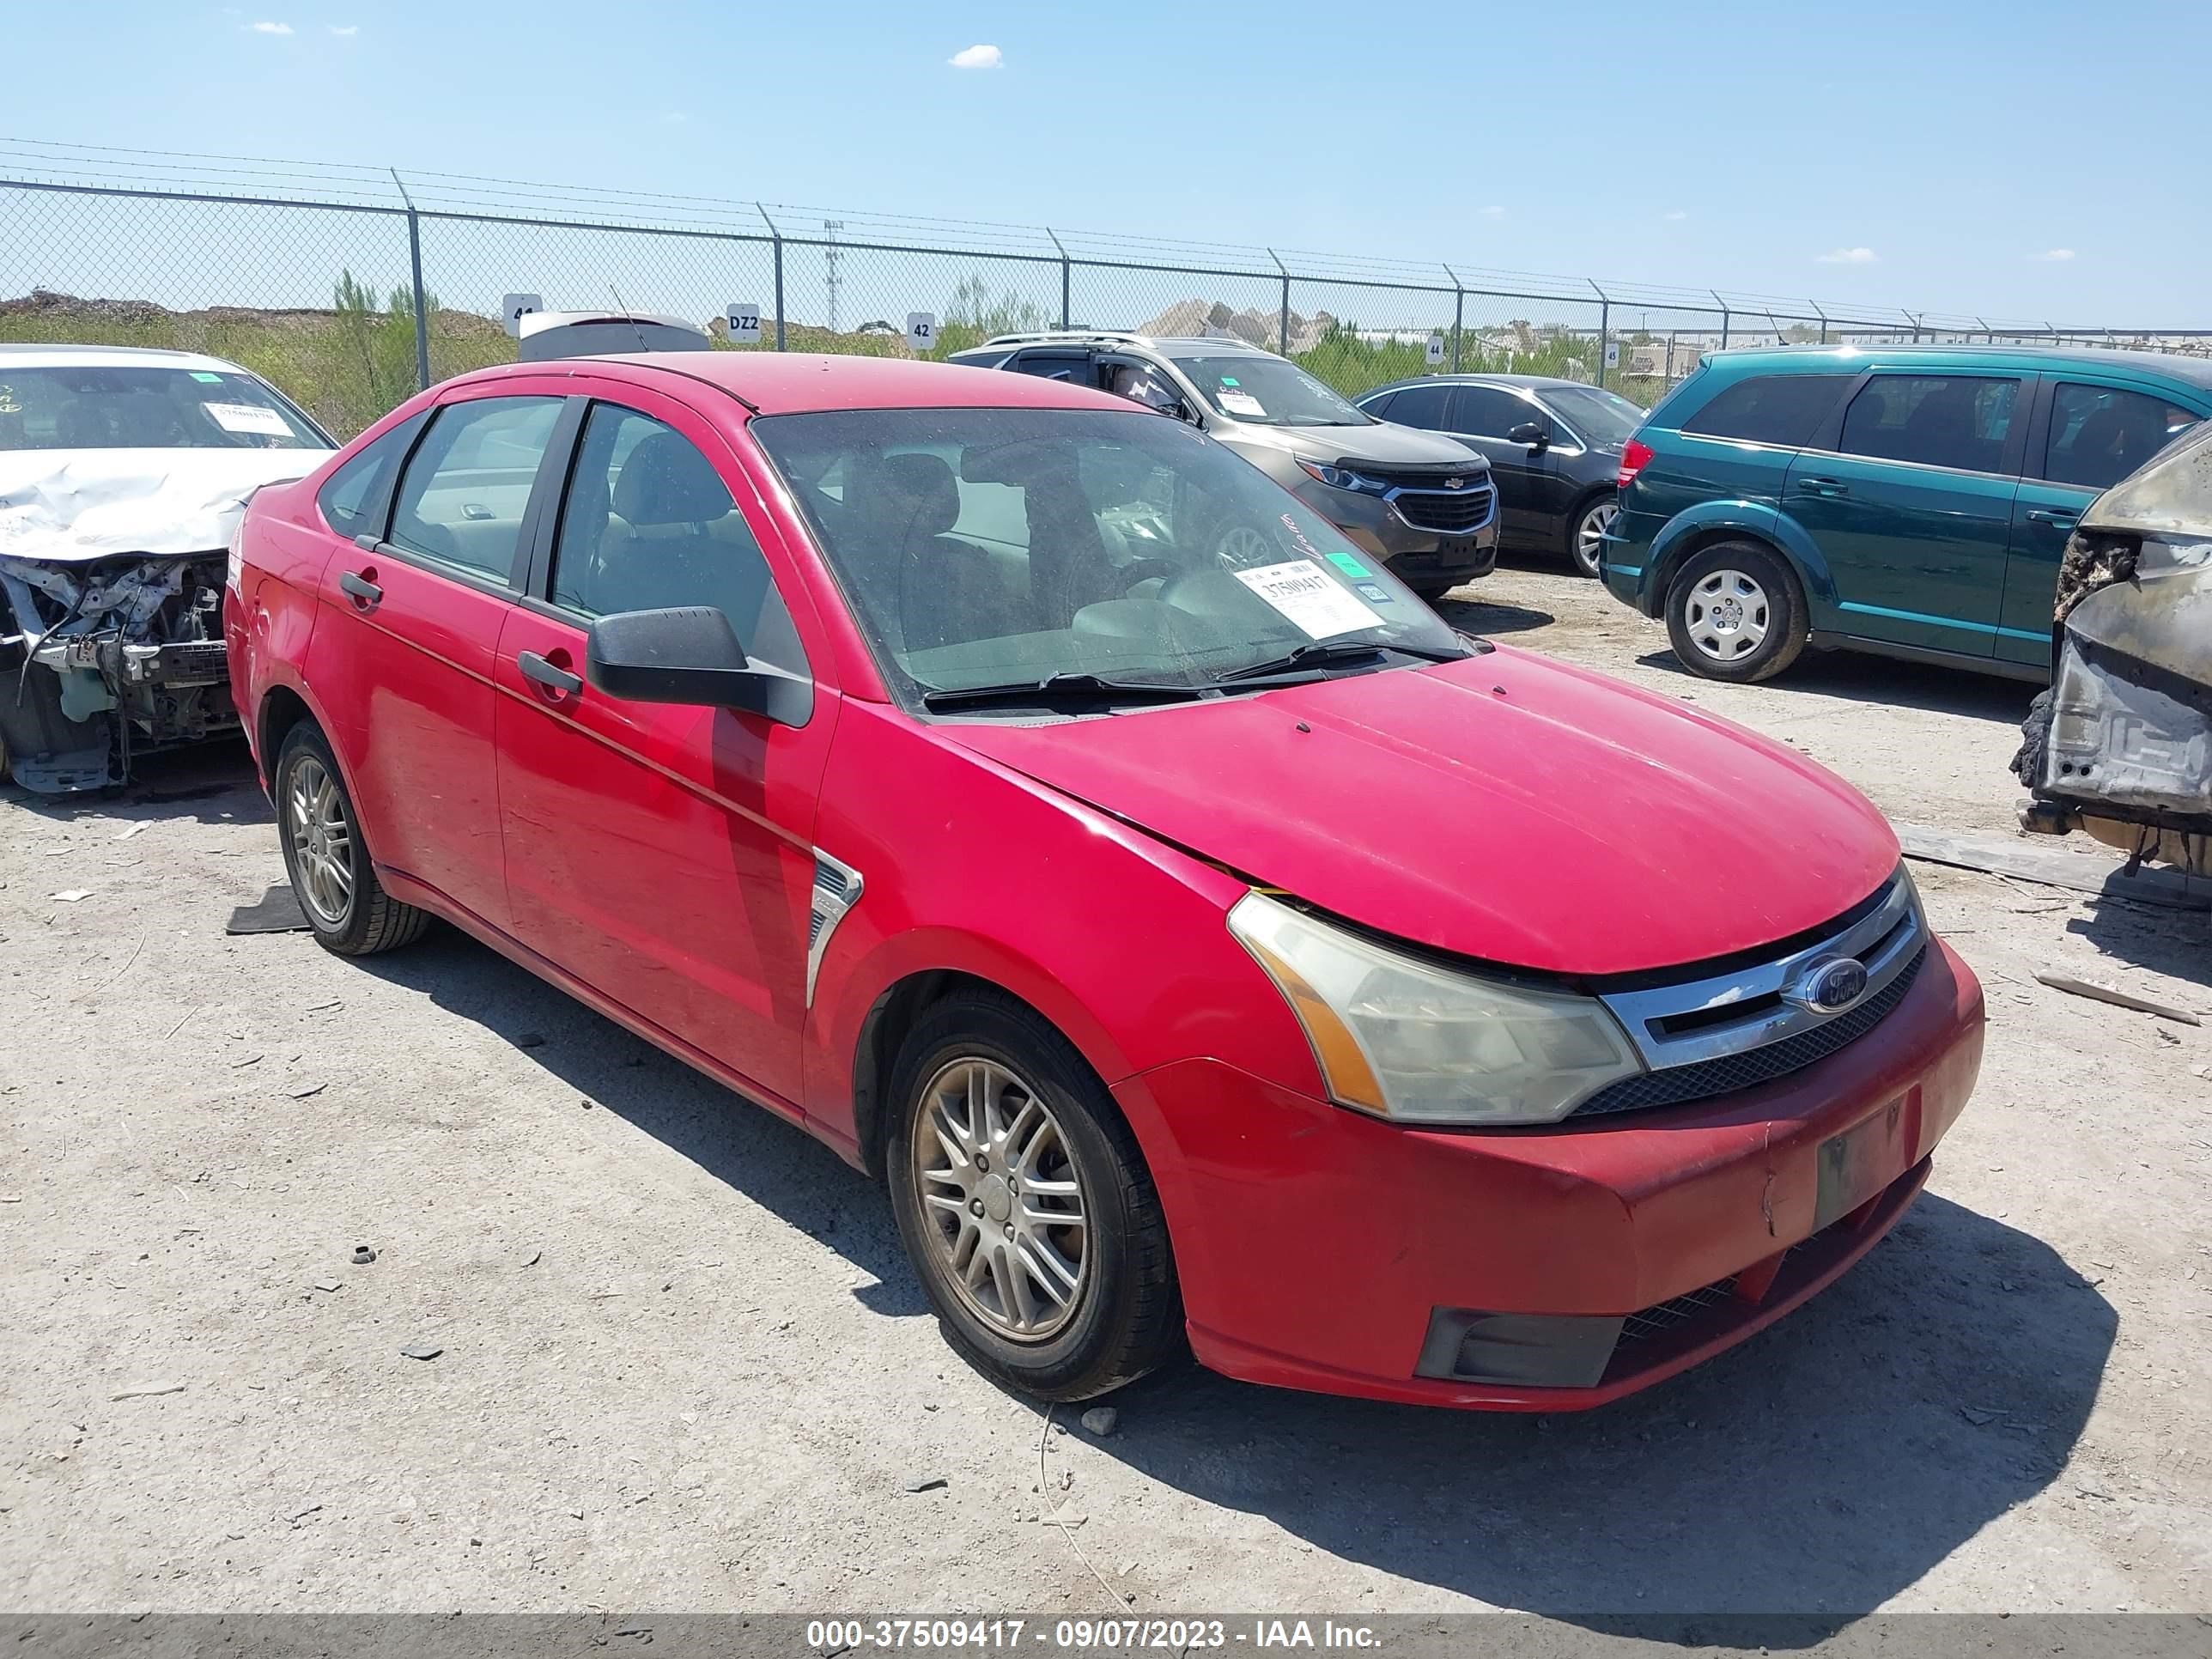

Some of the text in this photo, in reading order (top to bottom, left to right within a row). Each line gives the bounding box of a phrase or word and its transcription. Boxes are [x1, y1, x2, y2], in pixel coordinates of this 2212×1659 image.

[730, 316, 758, 330] DZ2
[914, 324, 930, 337] 42
[1430, 345, 1439, 355] 44
[1608, 351, 1616, 361] 45
[1261, 575, 1329, 598] 37509417
[1829, 968, 1860, 1005] Ford
